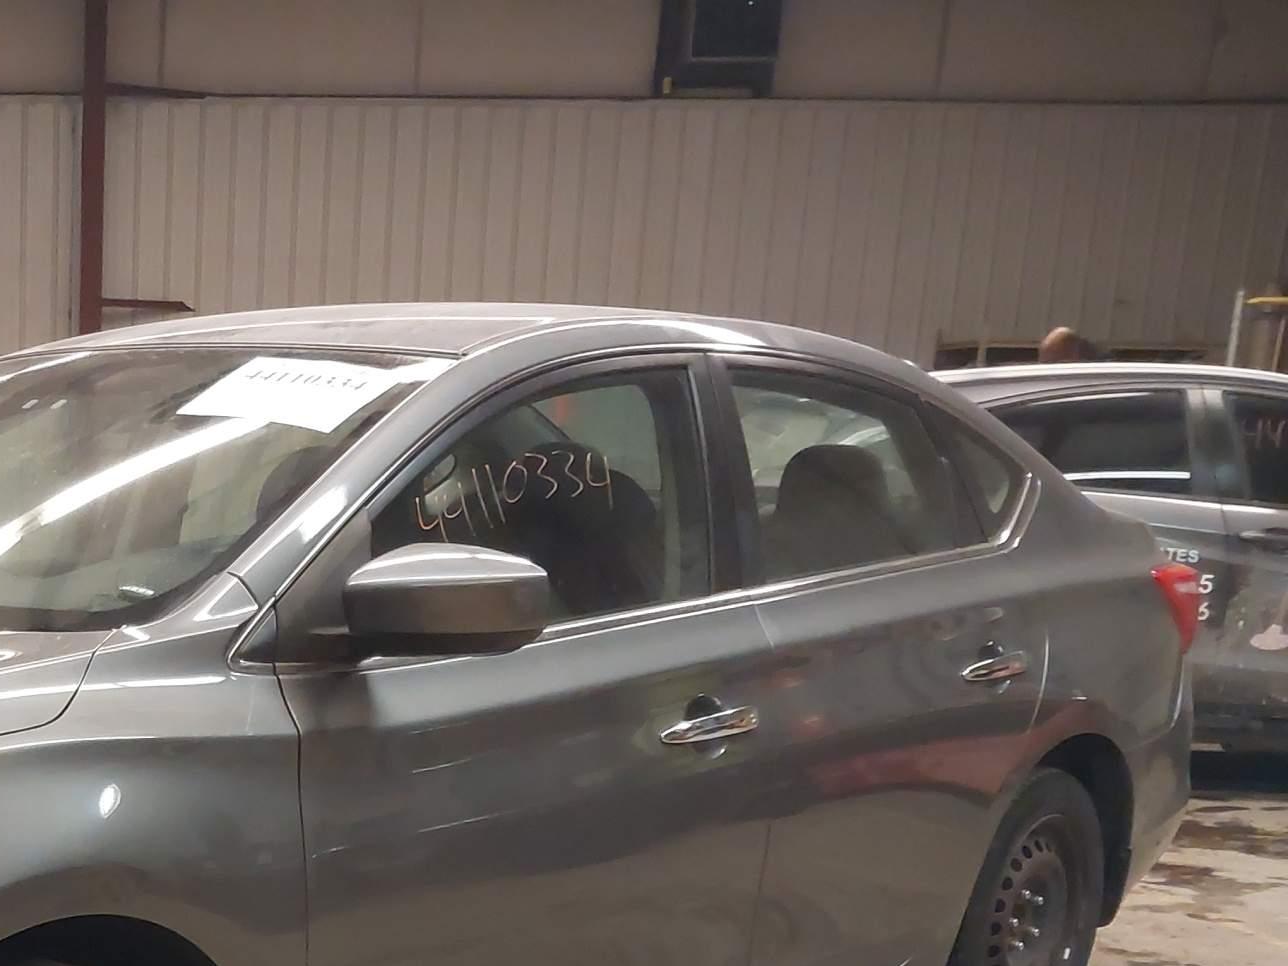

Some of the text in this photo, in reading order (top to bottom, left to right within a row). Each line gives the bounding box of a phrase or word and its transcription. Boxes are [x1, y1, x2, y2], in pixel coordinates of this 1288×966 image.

[244, 369, 370, 392] 44110334
[415, 450, 613, 542] 44110334
[1160, 547, 1200, 563] TES
[1198, 574, 1215, 594] 5
